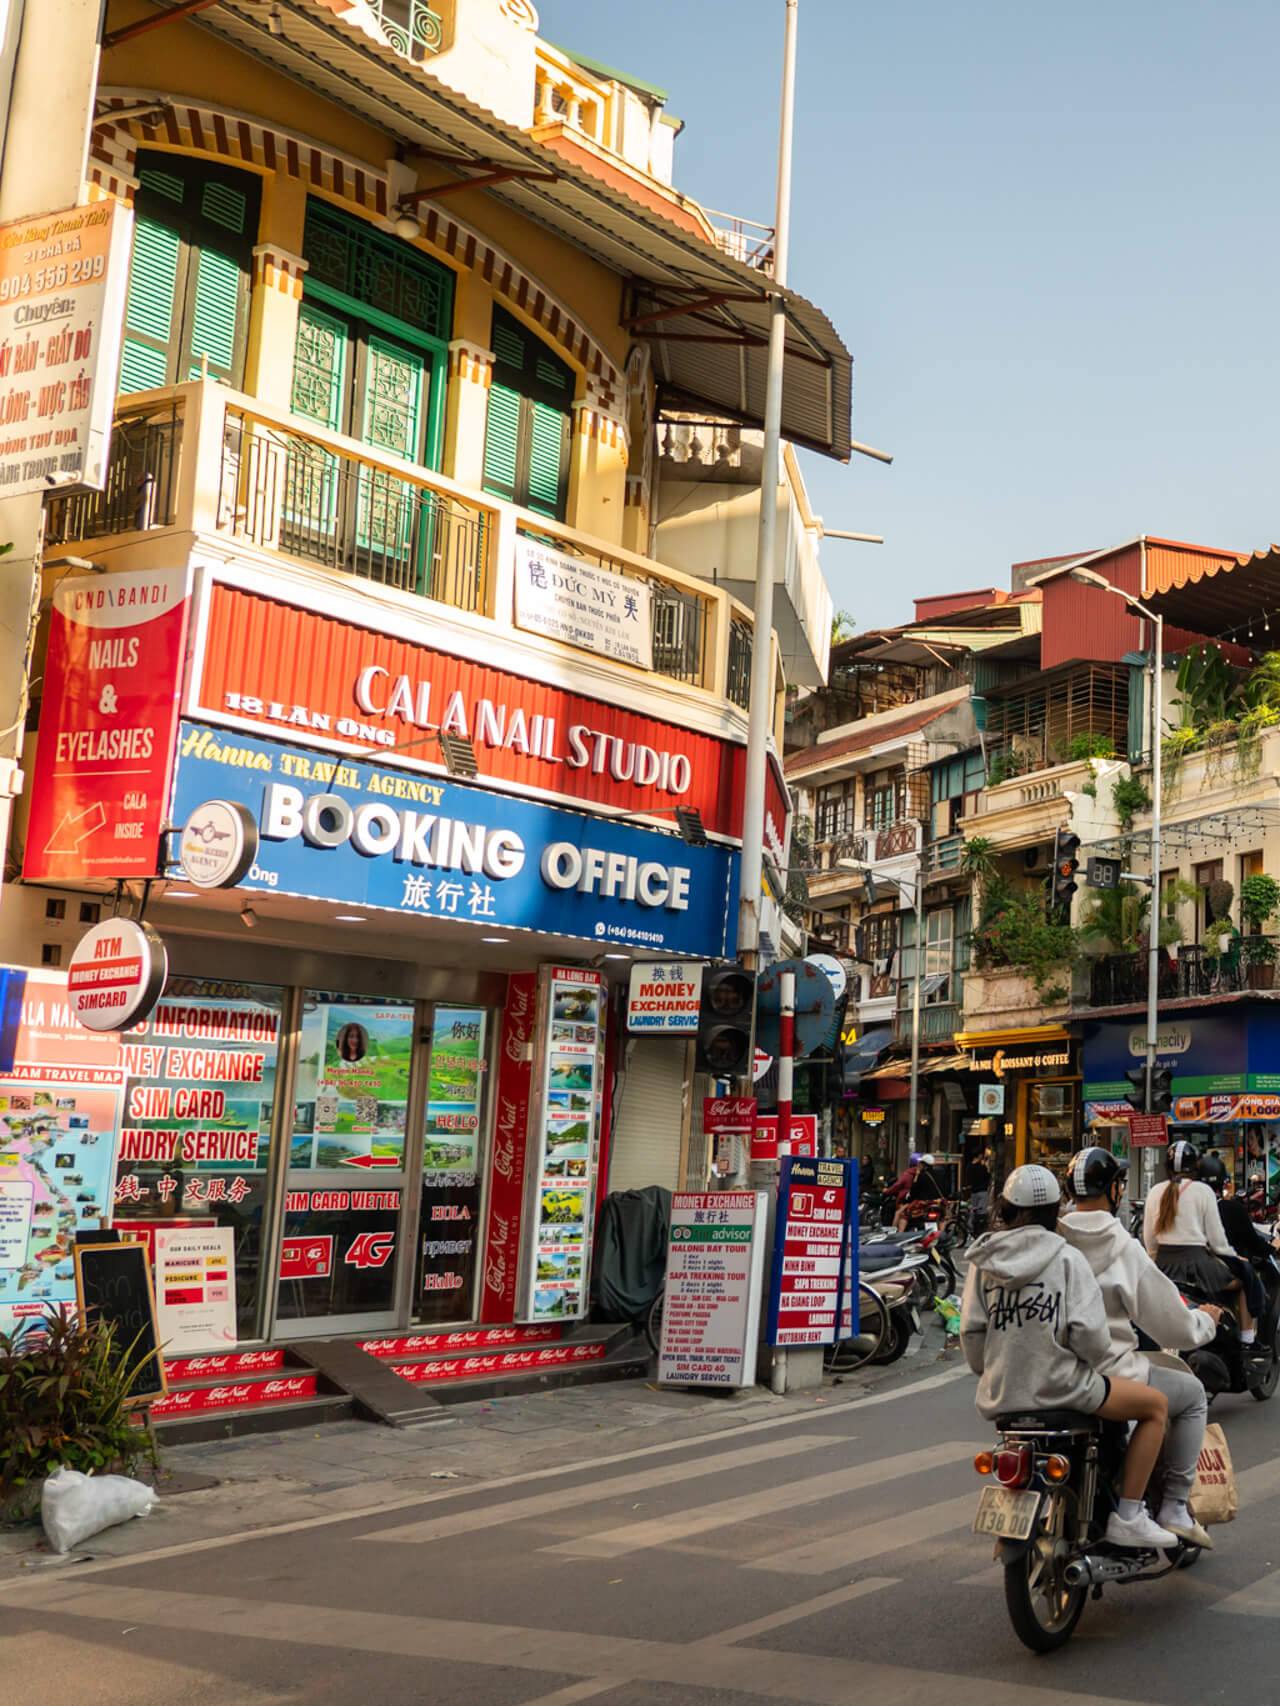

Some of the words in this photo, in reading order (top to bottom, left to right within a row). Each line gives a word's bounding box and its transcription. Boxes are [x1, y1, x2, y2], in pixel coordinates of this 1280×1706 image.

[24, 249, 37, 265] 21
[34, 263, 67, 292] 556
[70, 255, 105, 285] 299
[14, 298, 76, 325] Chuyên:
[623, 594, 640, 624] 美
[88, 637, 139, 670] NAILS
[98, 684, 118, 714] &
[224, 692, 264, 714] 18
[354, 665, 471, 737] CALA
[476, 697, 564, 763] NAIL
[566, 724, 692, 796] STUDIO
[56, 728, 154, 763] EYELASHES
[279, 753, 362, 790] TRAVEL
[367, 773, 445, 807] AGENCY
[123, 792, 147, 810] CALA
[114, 821, 145, 839] INSIDE
[260, 783, 526, 880] BOOKING
[540, 841, 692, 912] OFFICE
[401, 873, 497, 918] 旅行社
[94, 937, 122, 959] ATM
[72, 969, 98, 984] MONEY
[99, 964, 139, 982] EXCHANGE
[567, 969, 584, 981] LONG
[584, 971, 597, 983] BAY
[652, 965, 684, 981] 换钱
[639, 983, 696, 997] MONEY
[78, 991, 127, 1010] SIMCARD
[154, 1004, 277, 1043] INFORMATION
[629, 1015, 667, 1027] LAUNDRY
[451, 1019, 480, 1041] 你好
[166, 1048, 264, 1083] EXCHANGE
[434, 1055, 488, 1073] 안녕하세요
[1042, 1054, 1069, 1065] COFFEE
[45, 1067, 90, 1082] TRAVEL
[93, 1069, 122, 1082] MAP
[131, 1088, 170, 1118] SIM
[175, 1090, 224, 1119] CARD
[1211, 1096, 1231, 1105] BLACK
[1264, 1096, 1280, 1105] GIÁ
[861, 1111, 885, 1122] MASSAGE
[1210, 1105, 1232, 1115] FRIDAY
[436, 1114, 479, 1130] HELLO
[183, 1131, 258, 1160] SERVICE
[818, 1162, 844, 1175] TRAVEL
[817, 1175, 844, 1186] AGENCY
[284, 1192, 309, 1212] SIM
[311, 1191, 349, 1211] CARD
[351, 1191, 401, 1211] VIETTEL
[674, 1195, 705, 1208] MONEY
[707, 1195, 755, 1208] EXCHANGE
[823, 1190, 836, 1204] 4G
[431, 1205, 471, 1221] HOLA
[694, 1210, 730, 1223] 旅行社
[813, 1208, 825, 1220] SIM
[826, 1208, 842, 1221] CARD
[787, 1225, 807, 1238] MONEY
[809, 1227, 839, 1239] EXCHANGE
[345, 1232, 395, 1269] 4G
[423, 1239, 472, 1258] привет
[671, 1245, 705, 1253] HALONG
[706, 1245, 723, 1253] BAY
[725, 1245, 747, 1253] TOUR
[806, 1244, 827, 1256] HALONG
[828, 1245, 840, 1256] BAY
[165, 1258, 200, 1267] MANICURE
[784, 1260, 800, 1272] NINH
[801, 1260, 816, 1272] BINH
[165, 1274, 198, 1283] PEDICURE
[423, 1271, 463, 1290] Hallo
[669, 1272, 688, 1280] SAPA
[690, 1272, 725, 1281] TREKKING
[727, 1272, 746, 1281] TOUR
[794, 1277, 810, 1289] SAPA
[811, 1278, 837, 1290] TREKKING
[781, 1296, 790, 1307] HA
[791, 1295, 810, 1307] GIANG
[811, 1295, 826, 1307] LOOP
[808, 1313, 834, 1325] LAUNDRY
[807, 1331, 822, 1343] RENT
[691, 1364, 712, 1372] CARD
[666, 1372, 699, 1381] LAUNDRY
[701, 1374, 731, 1382] SERVICE
